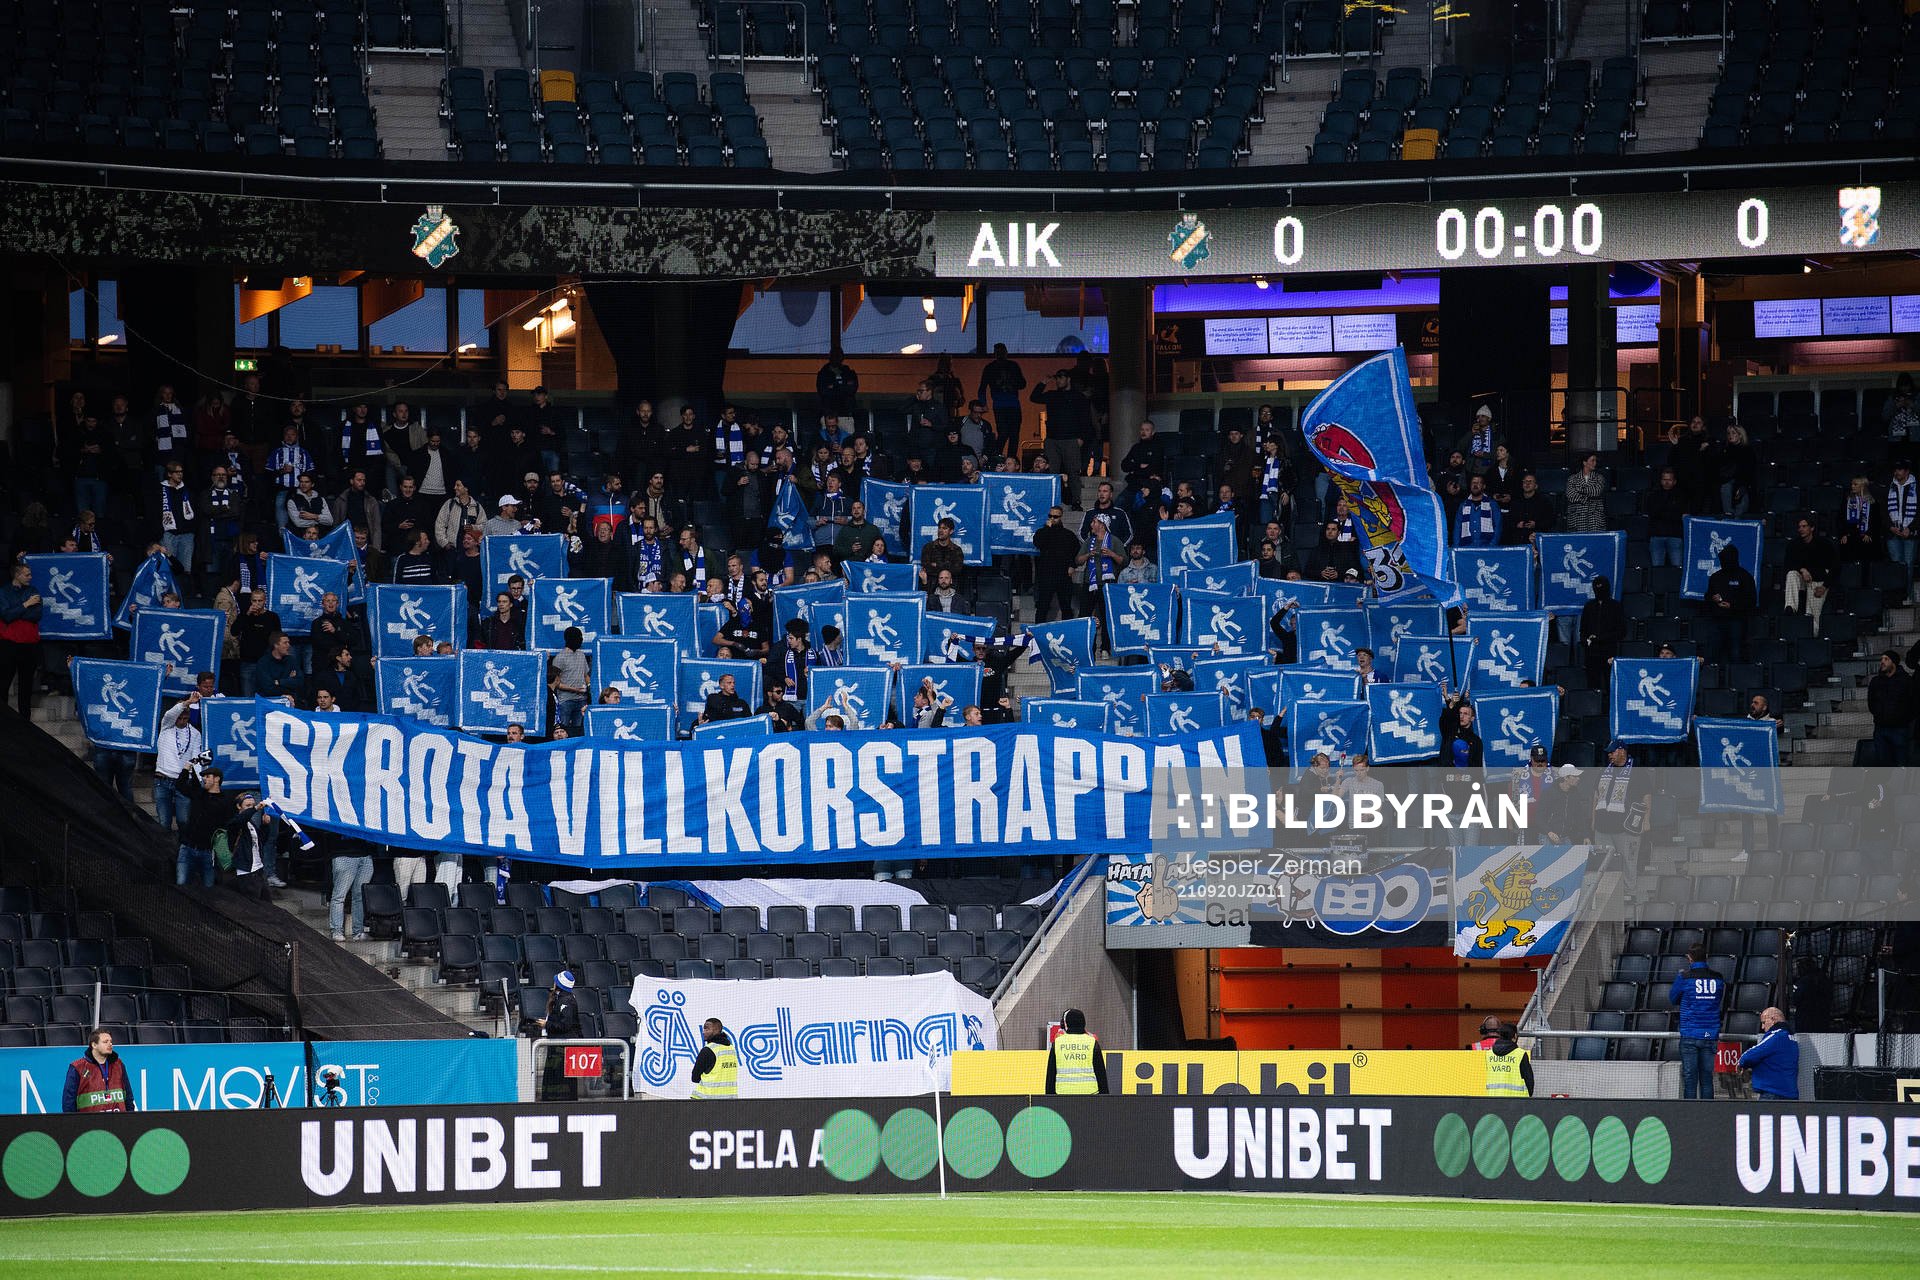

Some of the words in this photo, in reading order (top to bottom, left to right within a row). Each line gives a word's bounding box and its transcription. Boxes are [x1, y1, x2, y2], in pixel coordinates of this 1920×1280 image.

[967, 222, 1062, 268] AIK
[1274, 215, 1304, 265] 0
[1436, 203, 1603, 260] 00:00
[1737, 198, 1768, 248] 0
[265, 711, 534, 852] SKROTA
[549, 734, 1252, 856] VILLKORSTRAPPAN
[1107, 862, 1152, 882] HATA
[1695, 978, 1717, 994] SLO
[569, 1053, 598, 1070] 107
[1060, 1043, 1090, 1051] PUBLIK
[1488, 1055, 1516, 1064] PUBLIK
[1717, 1049, 1738, 1066] 103
[20, 1064, 379, 1114] MLMQVIST
[90, 1090, 124, 1104] PHOTO
[300, 1113, 617, 1197] UNIBET
[689, 1129, 799, 1170] SPELA
[1173, 1107, 1392, 1182] UNIBET
[1735, 1113, 1920, 1197] UNIBE
